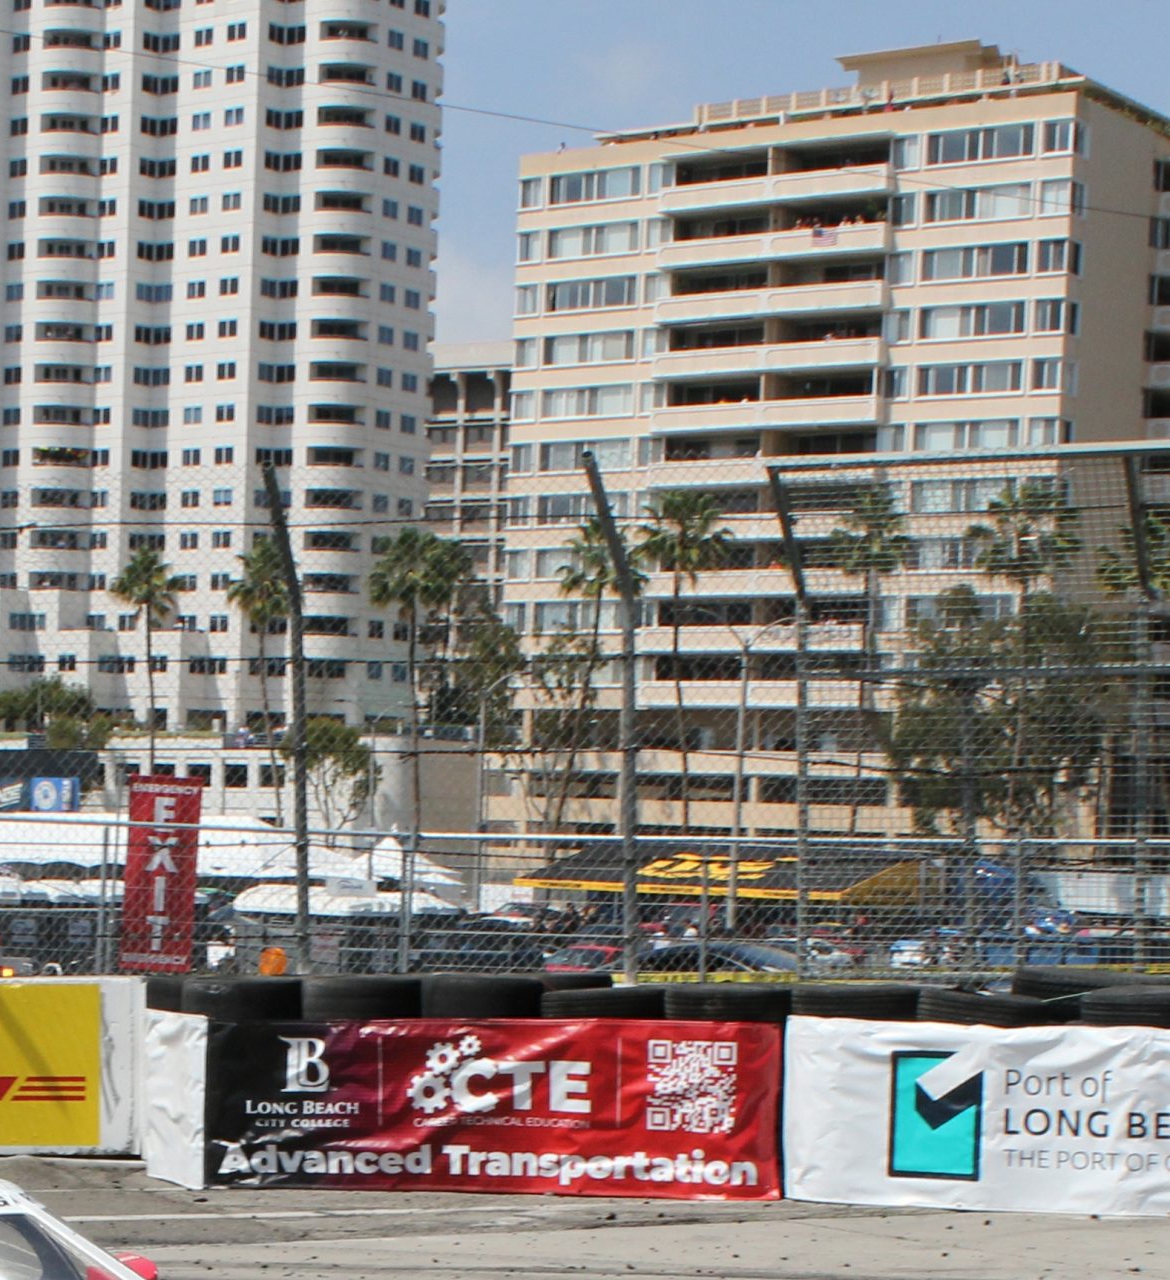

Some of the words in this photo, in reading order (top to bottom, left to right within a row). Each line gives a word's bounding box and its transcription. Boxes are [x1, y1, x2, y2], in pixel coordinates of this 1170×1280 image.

[132, 783, 201, 795] EMERGENCY
[145, 796, 179, 951] EXIT
[451, 1057, 591, 1113] CTE
[1004, 1068, 1072, 1097] Port
[1081, 1070, 1114, 1104] of
[245, 1099, 298, 1115] LONG
[303, 1100, 360, 1116] BEACH
[254, 1118, 286, 1128] CITY
[291, 1118, 350, 1129] COLLEGE
[460, 1116, 525, 1127] TECHNICAL
[526, 1117, 591, 1129] EDUCATION
[1003, 1107, 1111, 1138] LONG
[218, 1141, 432, 1176] Advanced
[441, 1144, 758, 1187] Transportation
[1003, 1148, 1049, 1169] THE
[1056, 1150, 1121, 1170] PORT
[1126, 1152, 1159, 1172] OF
